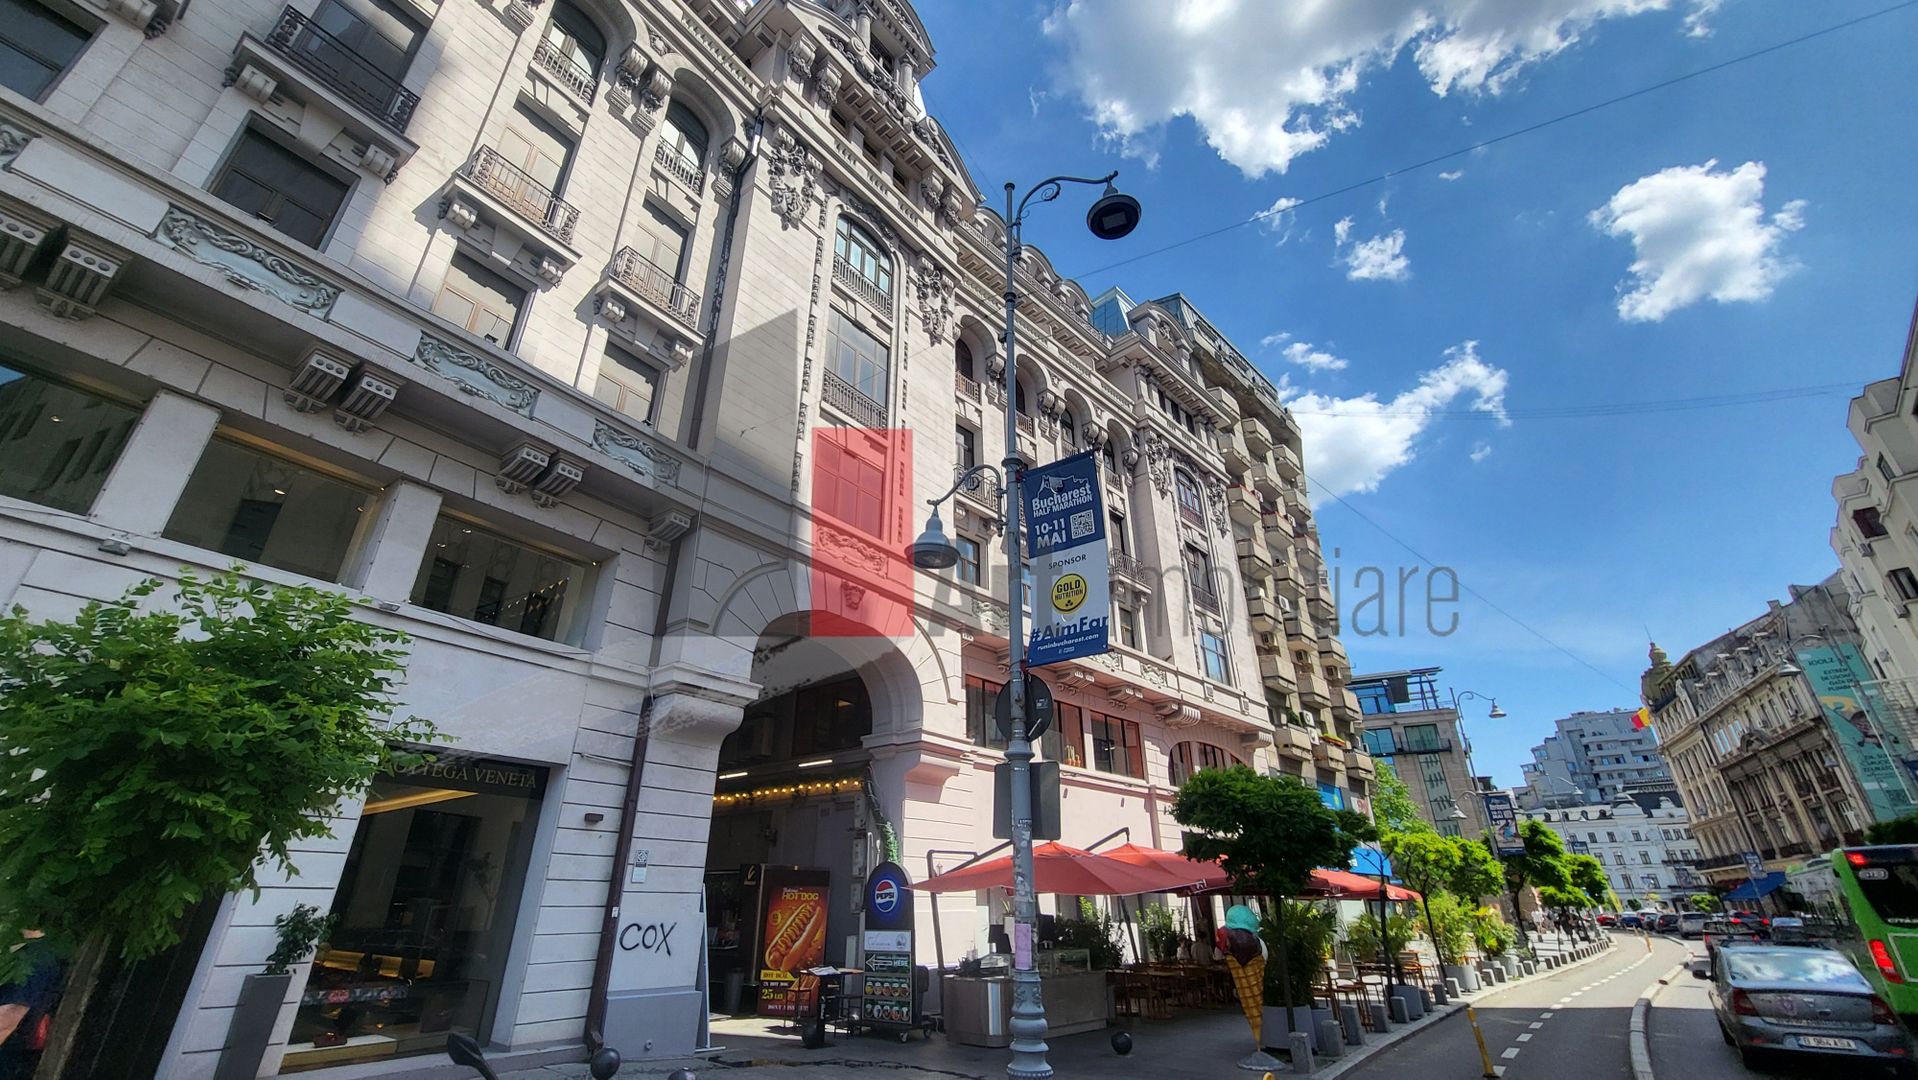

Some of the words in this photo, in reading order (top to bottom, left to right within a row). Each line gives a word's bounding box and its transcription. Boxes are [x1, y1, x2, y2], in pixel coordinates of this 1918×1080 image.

[1032, 483, 1092, 511] Bucharest
[1033, 506, 1053, 518] HALF
[1052, 494, 1093, 513] MARATHON
[1035, 518, 1066, 536] 10-11
[1037, 530, 1067, 549] MAI
[1048, 554, 1087, 569] SPONSOR
[1054, 588, 1084, 601] NUTRITION
[1056, 579, 1081, 593] GOLD
[473, 767, 536, 789] VENETA
[800, 892, 819, 901] DOG
[876, 892, 895, 900] PEPSI
[619, 922, 677, 957] COX
